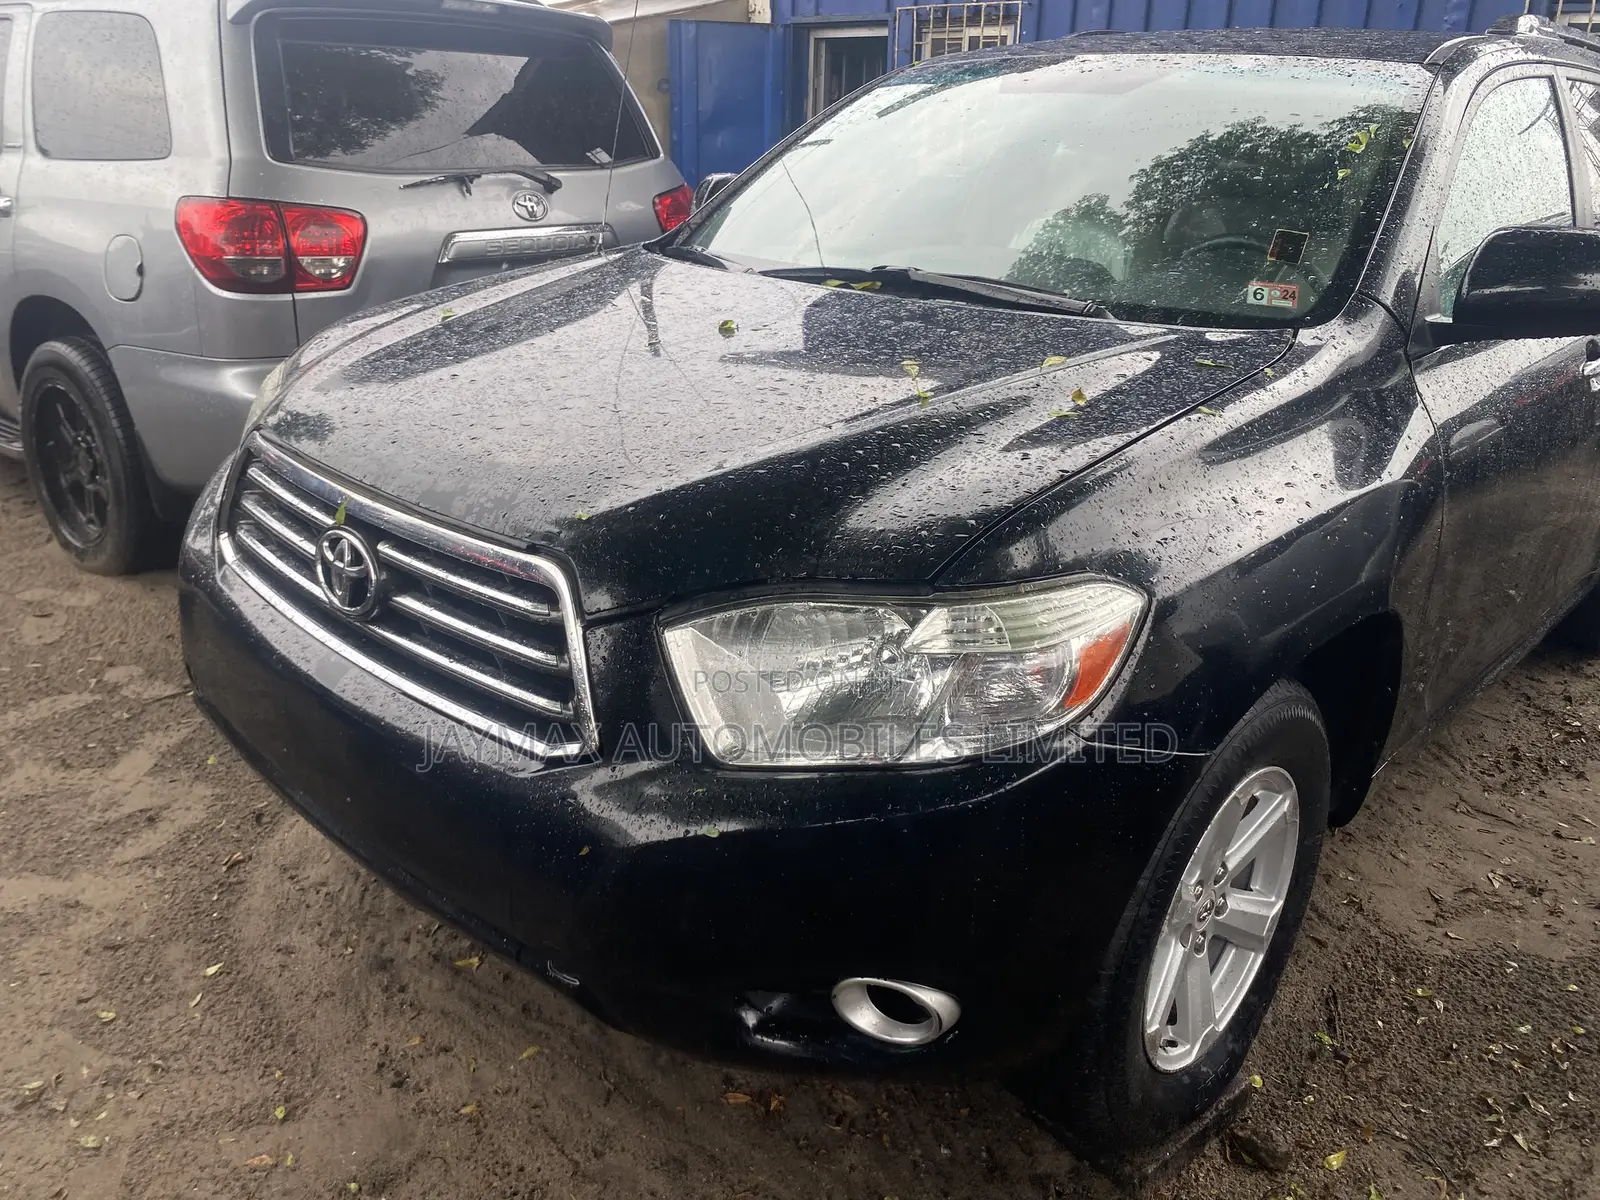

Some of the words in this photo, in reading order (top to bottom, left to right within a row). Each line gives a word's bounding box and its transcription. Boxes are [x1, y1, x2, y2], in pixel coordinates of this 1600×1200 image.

[485, 235, 591, 256] SEQUOIA
[1252, 287, 1265, 301] 6
[1281, 289, 1297, 301] 24
